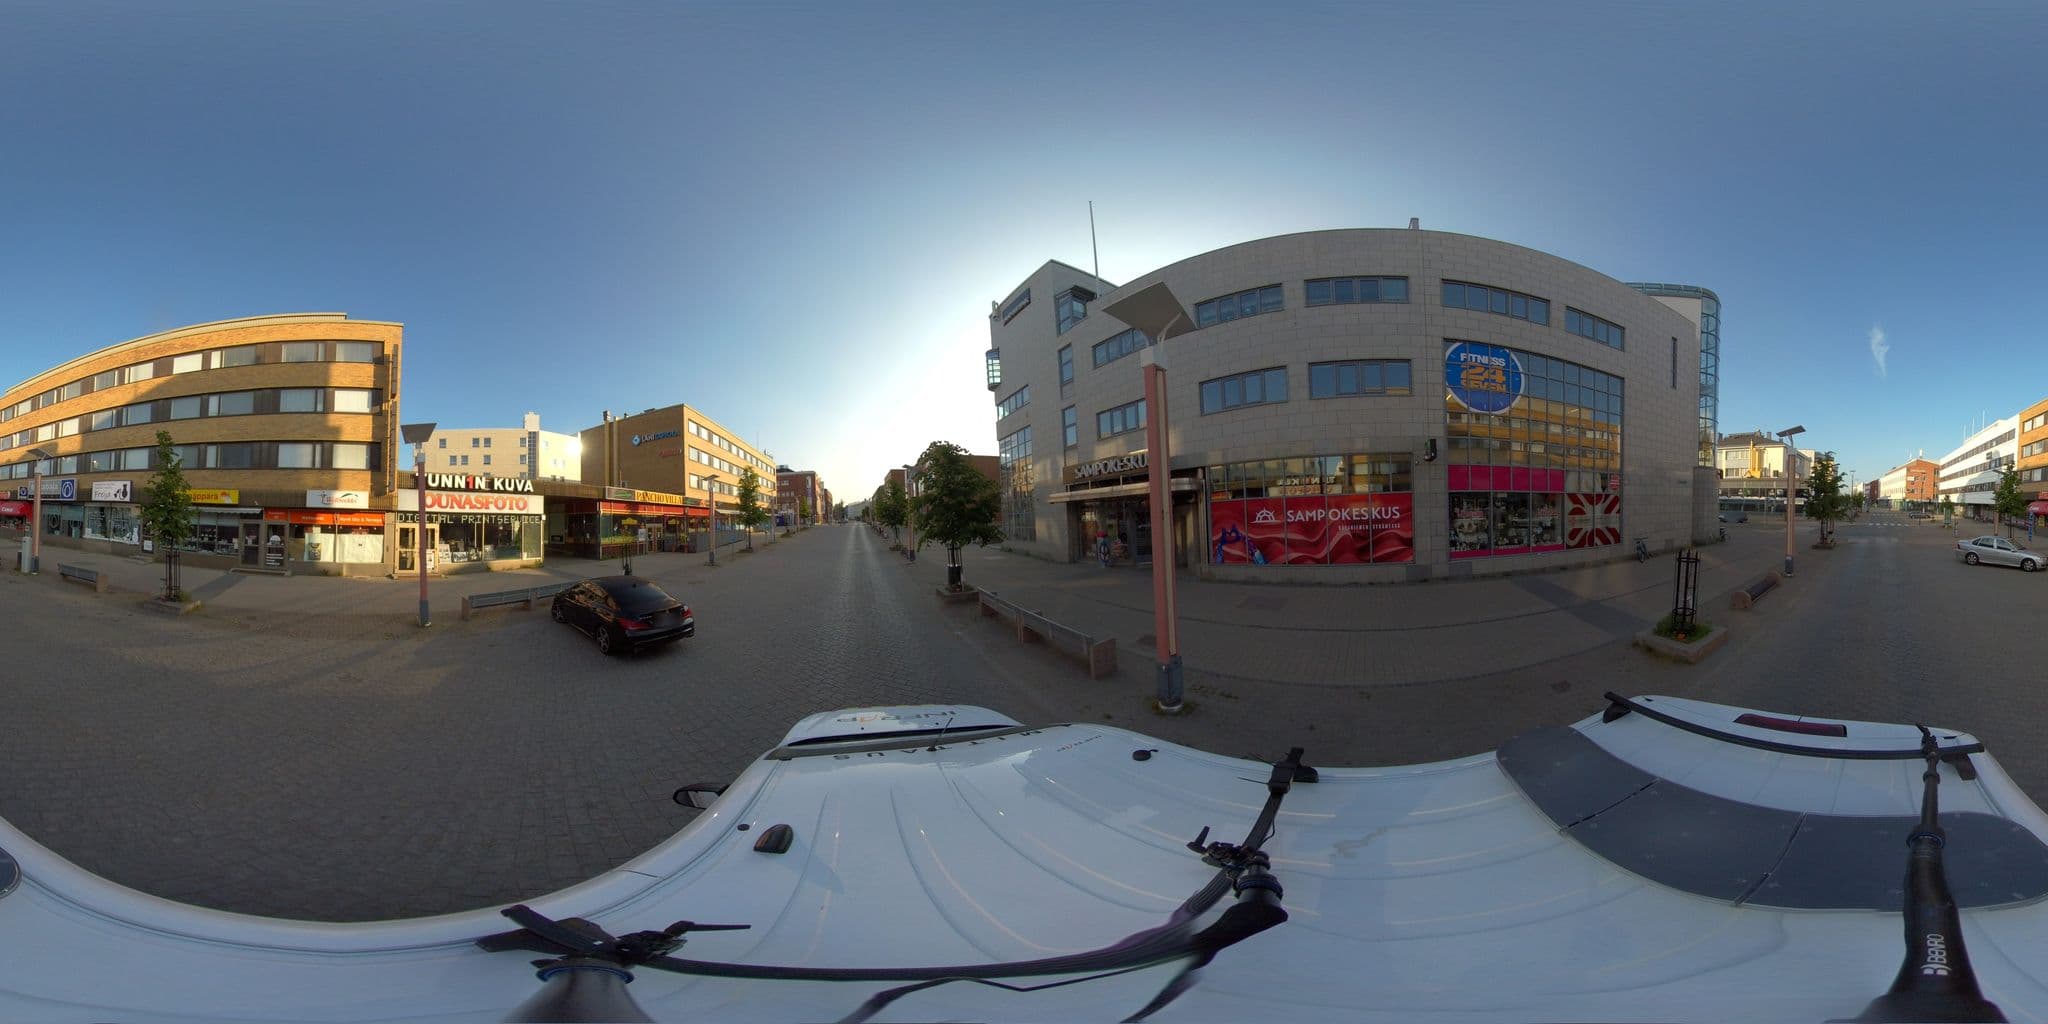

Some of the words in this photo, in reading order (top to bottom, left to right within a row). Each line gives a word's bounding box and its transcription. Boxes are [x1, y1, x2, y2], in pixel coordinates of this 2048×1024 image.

[1460, 353, 1506, 366] FITNESS
[1461, 362, 1506, 383] 24
[1461, 381, 1507, 392] SEVEN
[1075, 454, 1148, 479] SAMPOKESKU
[416, 473, 486, 490] UNN1N
[494, 478, 534, 493] KUVA
[636, 492, 664, 503] PANCHO
[664, 495, 683, 505] VILLA
[461, 514, 541, 525] PRINTSERVICE
[1287, 506, 1400, 523] SAMPOKESKUS
[1926, 934, 1947, 964] BENRO
